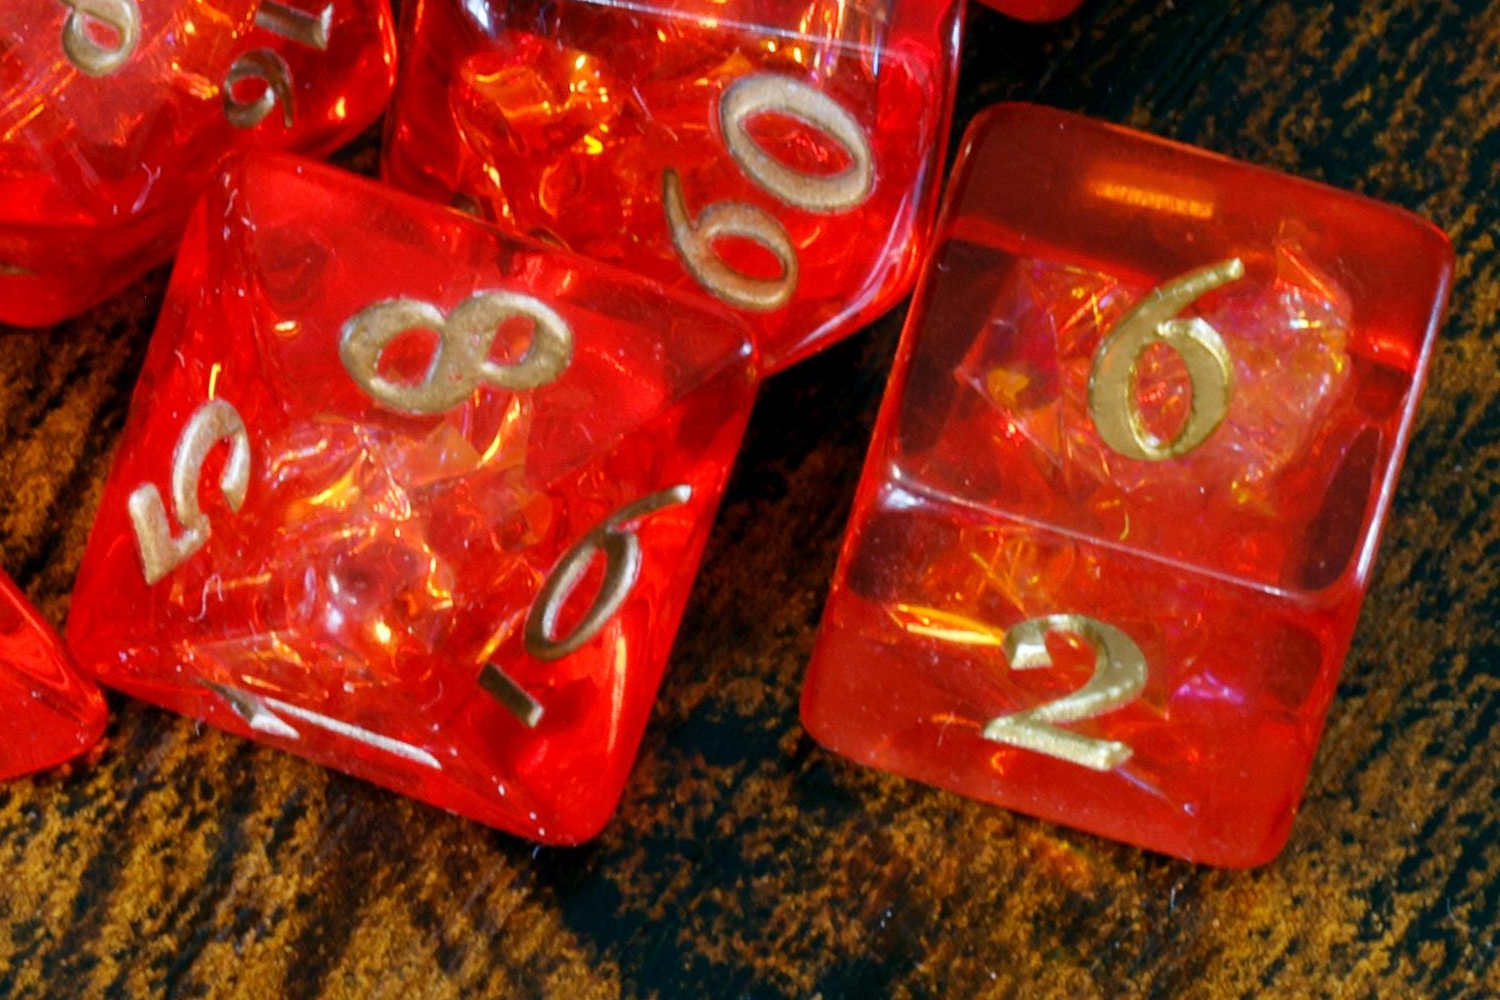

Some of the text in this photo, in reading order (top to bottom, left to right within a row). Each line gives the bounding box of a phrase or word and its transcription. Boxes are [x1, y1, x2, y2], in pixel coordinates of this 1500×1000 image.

[340, 289, 573, 415] 8
[1087, 257, 1245, 461] 6
[128, 399, 251, 586] 5
[983, 613, 1148, 770] 2
